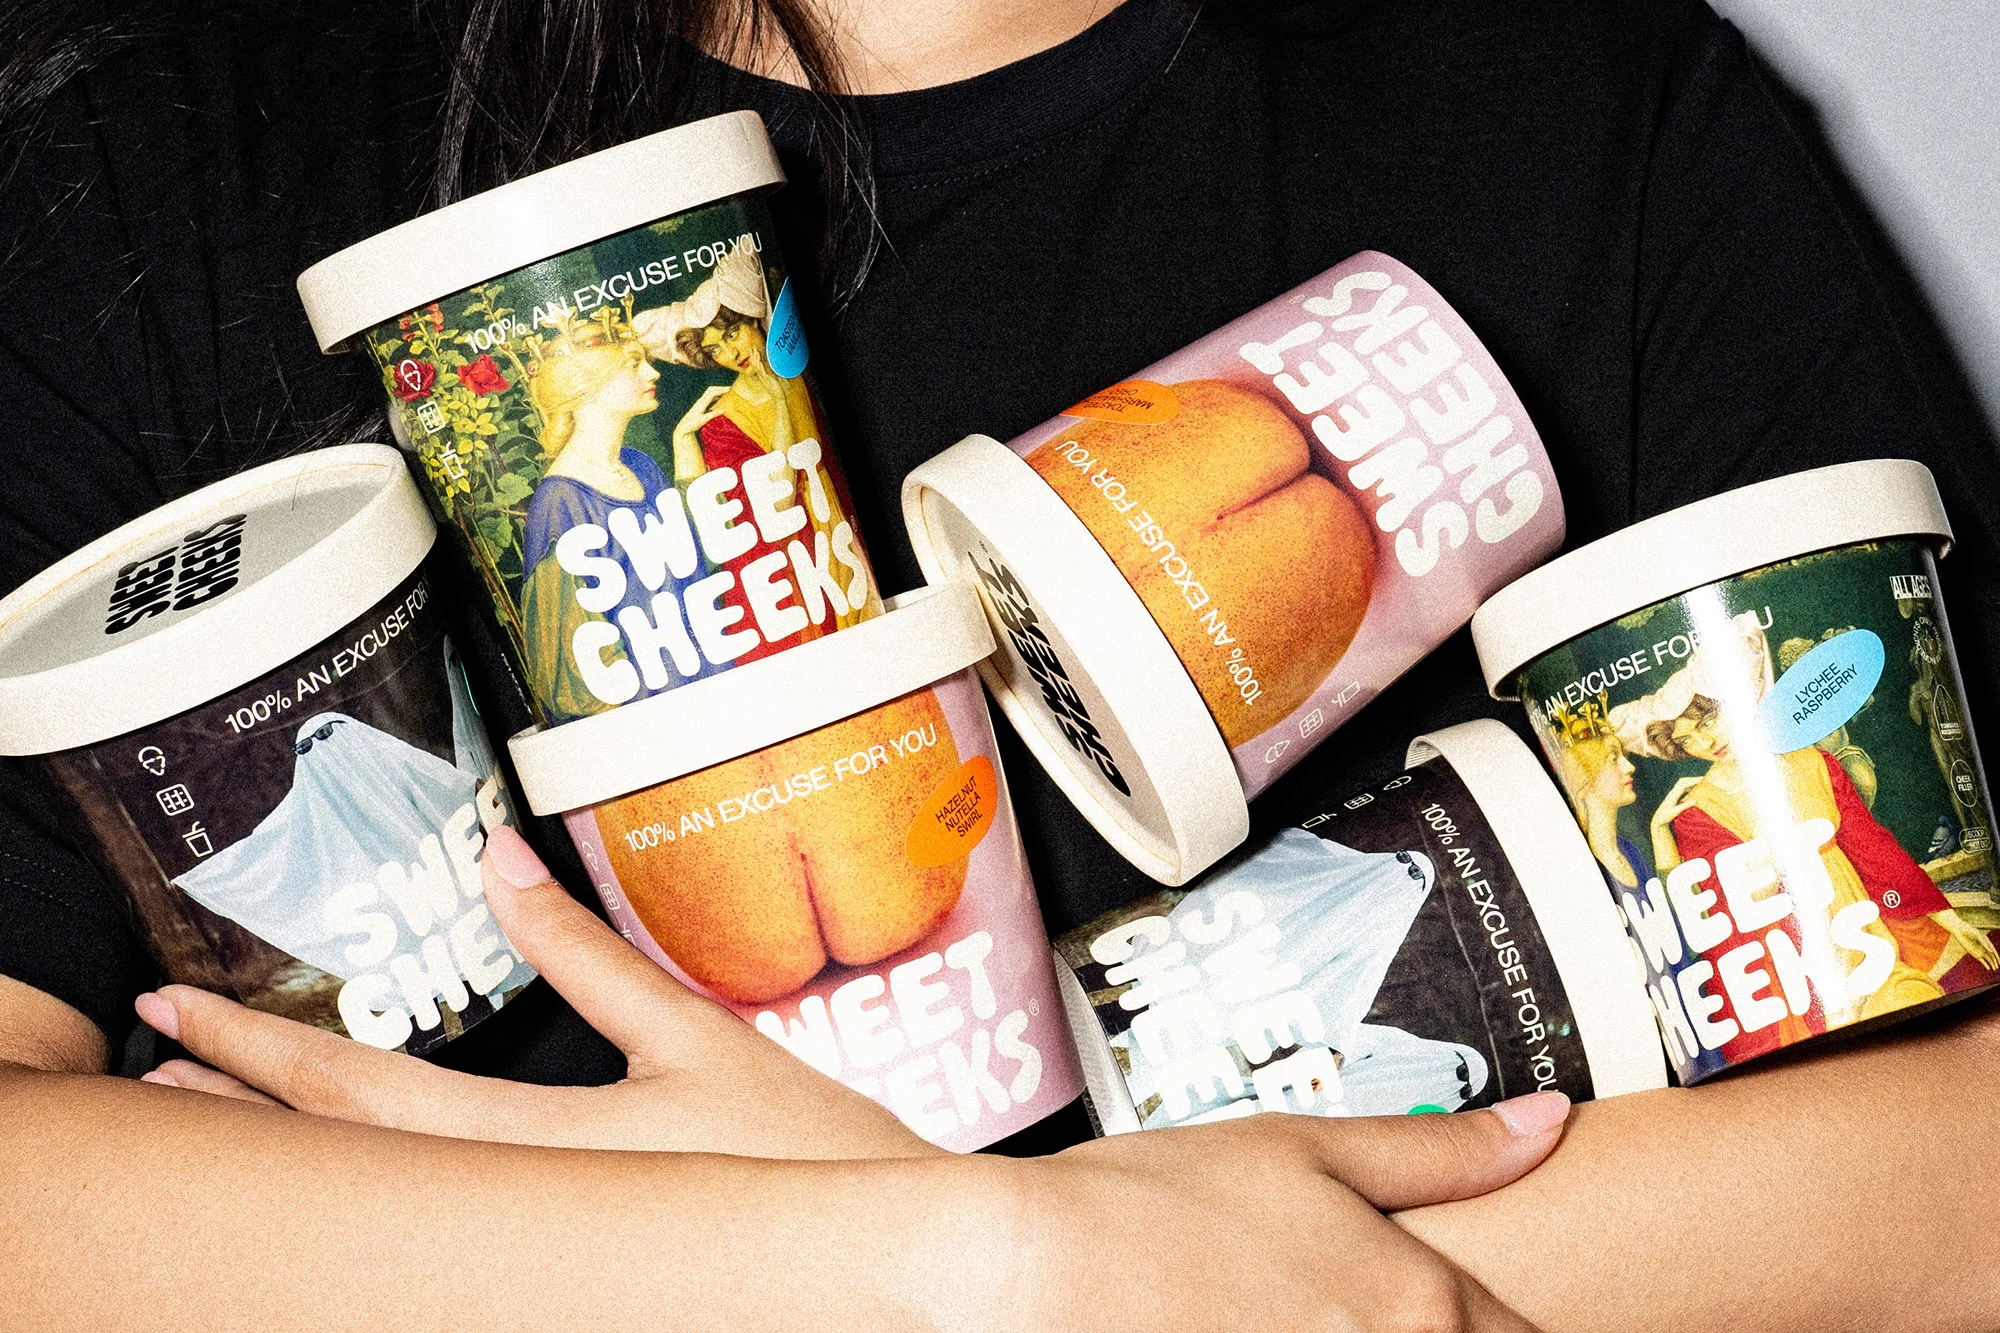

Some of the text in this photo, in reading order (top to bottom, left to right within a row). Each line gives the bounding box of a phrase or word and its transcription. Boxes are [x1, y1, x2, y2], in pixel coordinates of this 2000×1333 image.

[464, 231, 762, 354] 100% AN EXCUSE FOR YOU
[1239, 321, 1469, 577] SWEET
[1303, 271, 1544, 543] CHEEKS
[105, 546, 179, 634] SWEET
[173, 514, 247, 611] CHEEKS
[556, 438, 830, 613] SWEET
[1055, 440, 1262, 706] 100% AN EXCUSE FOR YOU
[225, 581, 428, 733] 100% AN EXCUSE FOR
[572, 520, 867, 705] CHEEKS
[1545, 691, 1567, 721] AN
[1564, 650, 1651, 707] EXCUSE
[1795, 662, 1841, 704] LYCHEE
[1793, 664, 1857, 724] RASPBERRY
[624, 723, 937, 852] 100% AN EXCUSE FOR YOU
[935, 776, 977, 823] HAZELNUT
[945, 791, 981, 832] NUTELLA
[957, 809, 983, 837] SWIRL
[321, 774, 507, 967] SWEE
[1420, 803, 1461, 845] 100%
[1447, 847, 1481, 879] AN
[1467, 878, 1528, 986] EXCUSE
[1511, 987, 1545, 1045] FOR
[1617, 818, 1835, 984] WEET
[337, 904, 525, 1050] CHE
[755, 931, 996, 1078] WEET
[1090, 915, 1256, 1126] CHEE
[1179, 891, 1348, 1117] SWEE
[849, 1009, 1043, 1140] EKS
